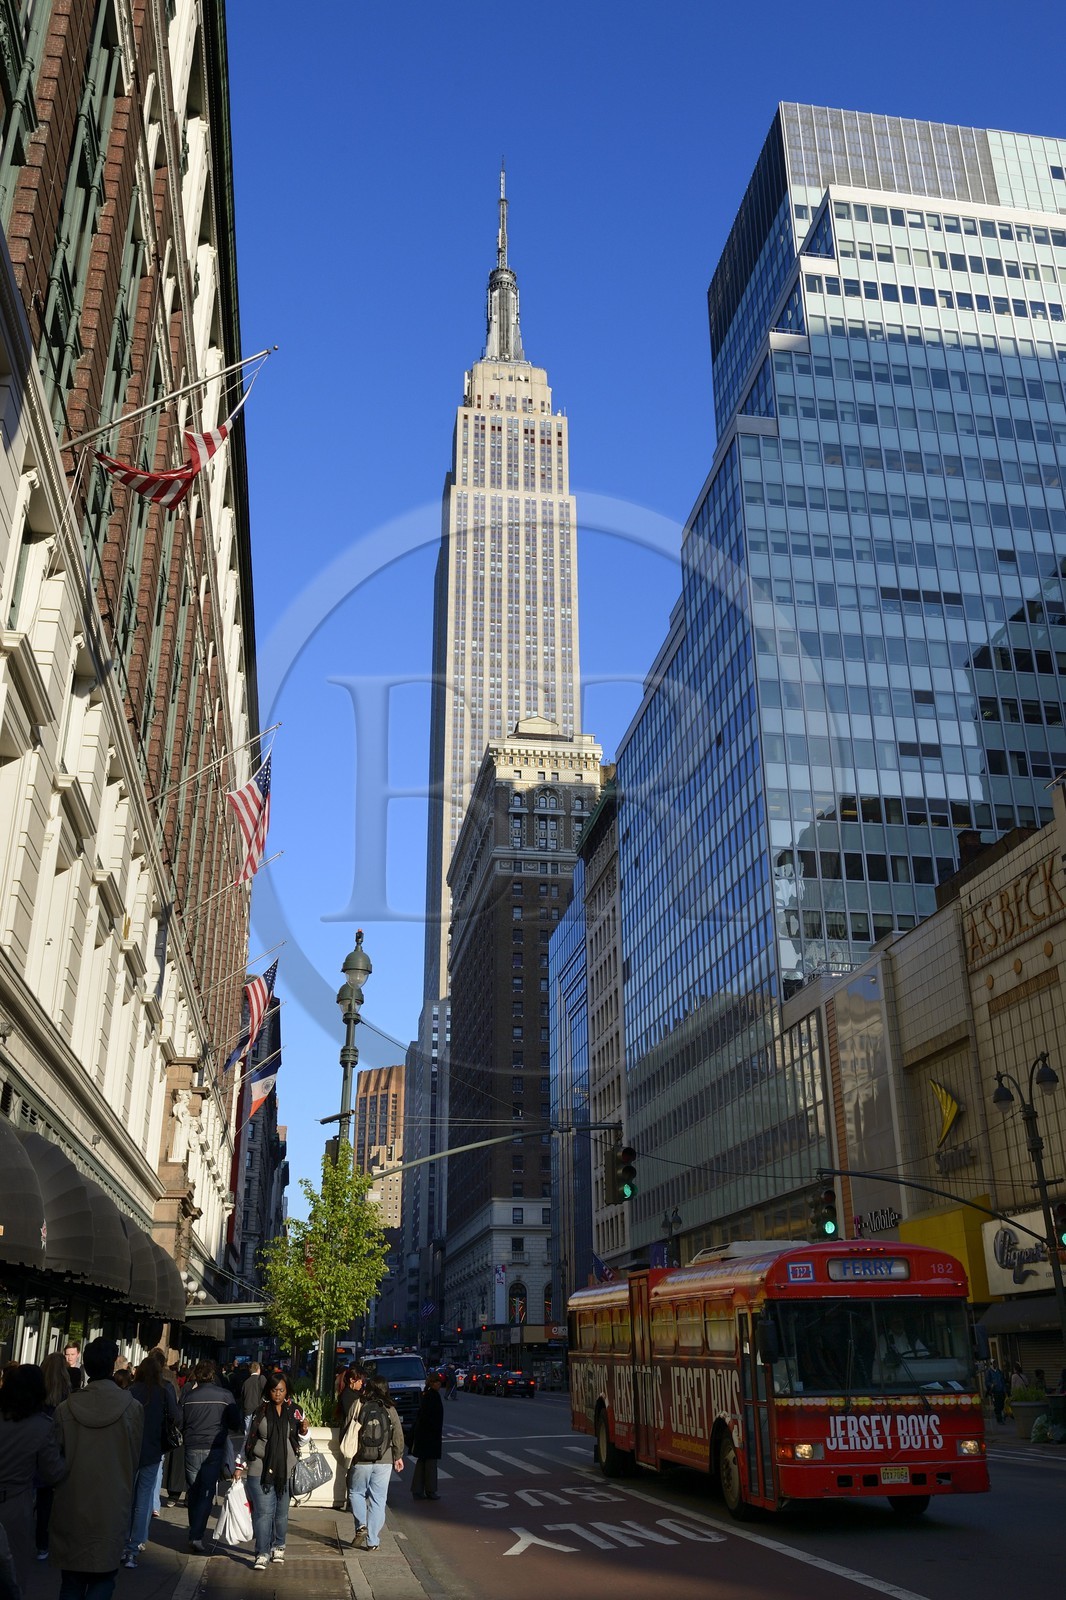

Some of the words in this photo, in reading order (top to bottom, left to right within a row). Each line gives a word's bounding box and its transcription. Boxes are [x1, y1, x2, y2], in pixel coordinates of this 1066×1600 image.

[842, 1257, 895, 1276] FERRY
[930, 1263, 953, 1274] 182
[670, 1366, 709, 1440] JERSEY
[826, 1414, 892, 1450] JERSEY
[896, 1414, 944, 1449] BOYS
[474, 1486, 626, 1509] BUS
[503, 1518, 728, 1555] ONLY
